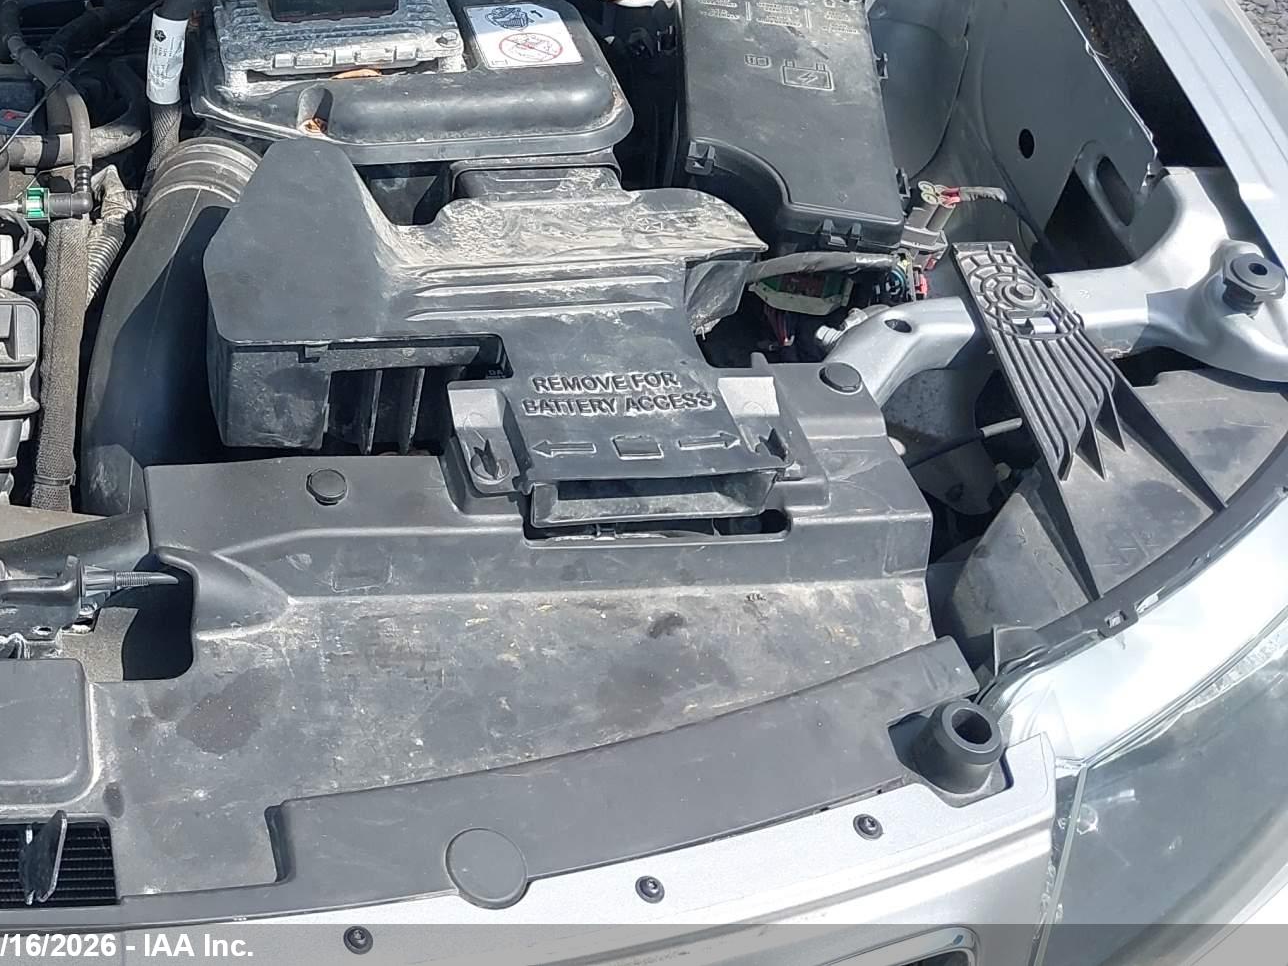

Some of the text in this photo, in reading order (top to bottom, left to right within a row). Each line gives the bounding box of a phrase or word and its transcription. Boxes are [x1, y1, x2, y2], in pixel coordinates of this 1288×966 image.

[532, 371, 680, 392] REMOVE FOR
[521, 390, 715, 415] BATTERY ACCESS
